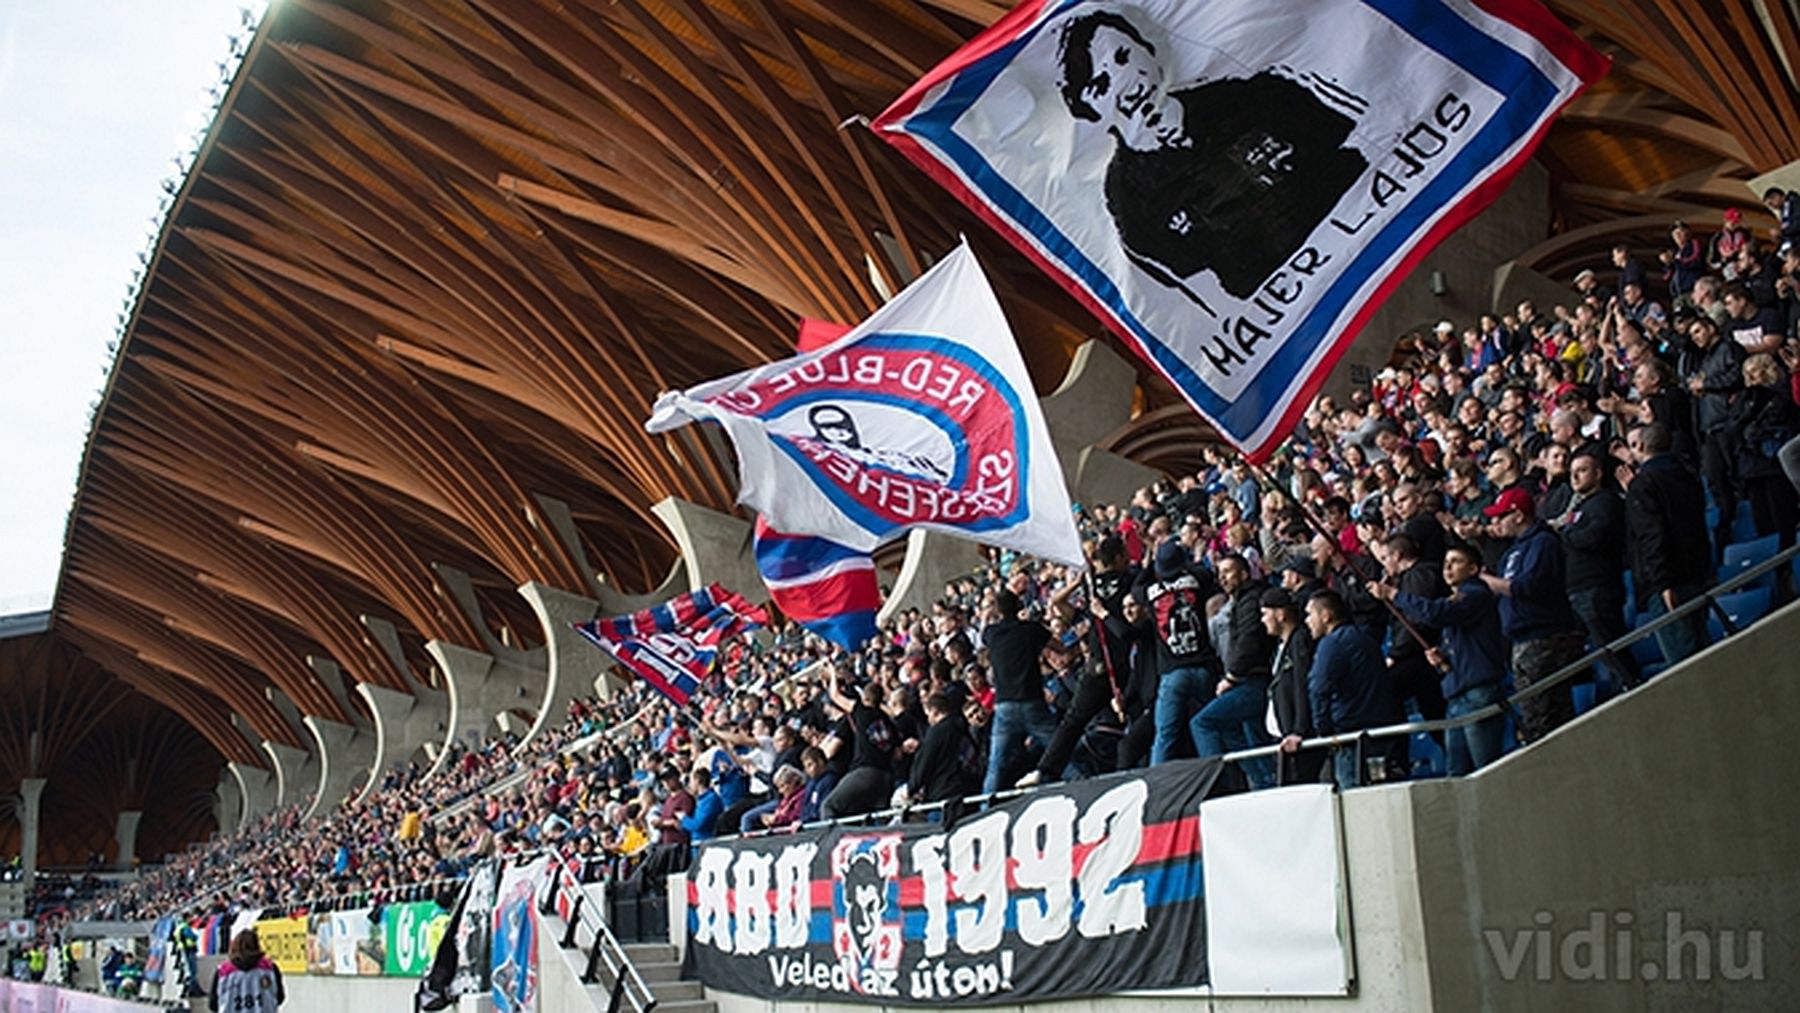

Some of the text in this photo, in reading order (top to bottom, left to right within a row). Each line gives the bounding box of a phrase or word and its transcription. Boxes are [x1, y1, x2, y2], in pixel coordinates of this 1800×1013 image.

[1330, 91, 1472, 235] LAJOS
[912, 780, 1148, 957] 1992
[768, 949, 1015, 998] Veled az úton!
